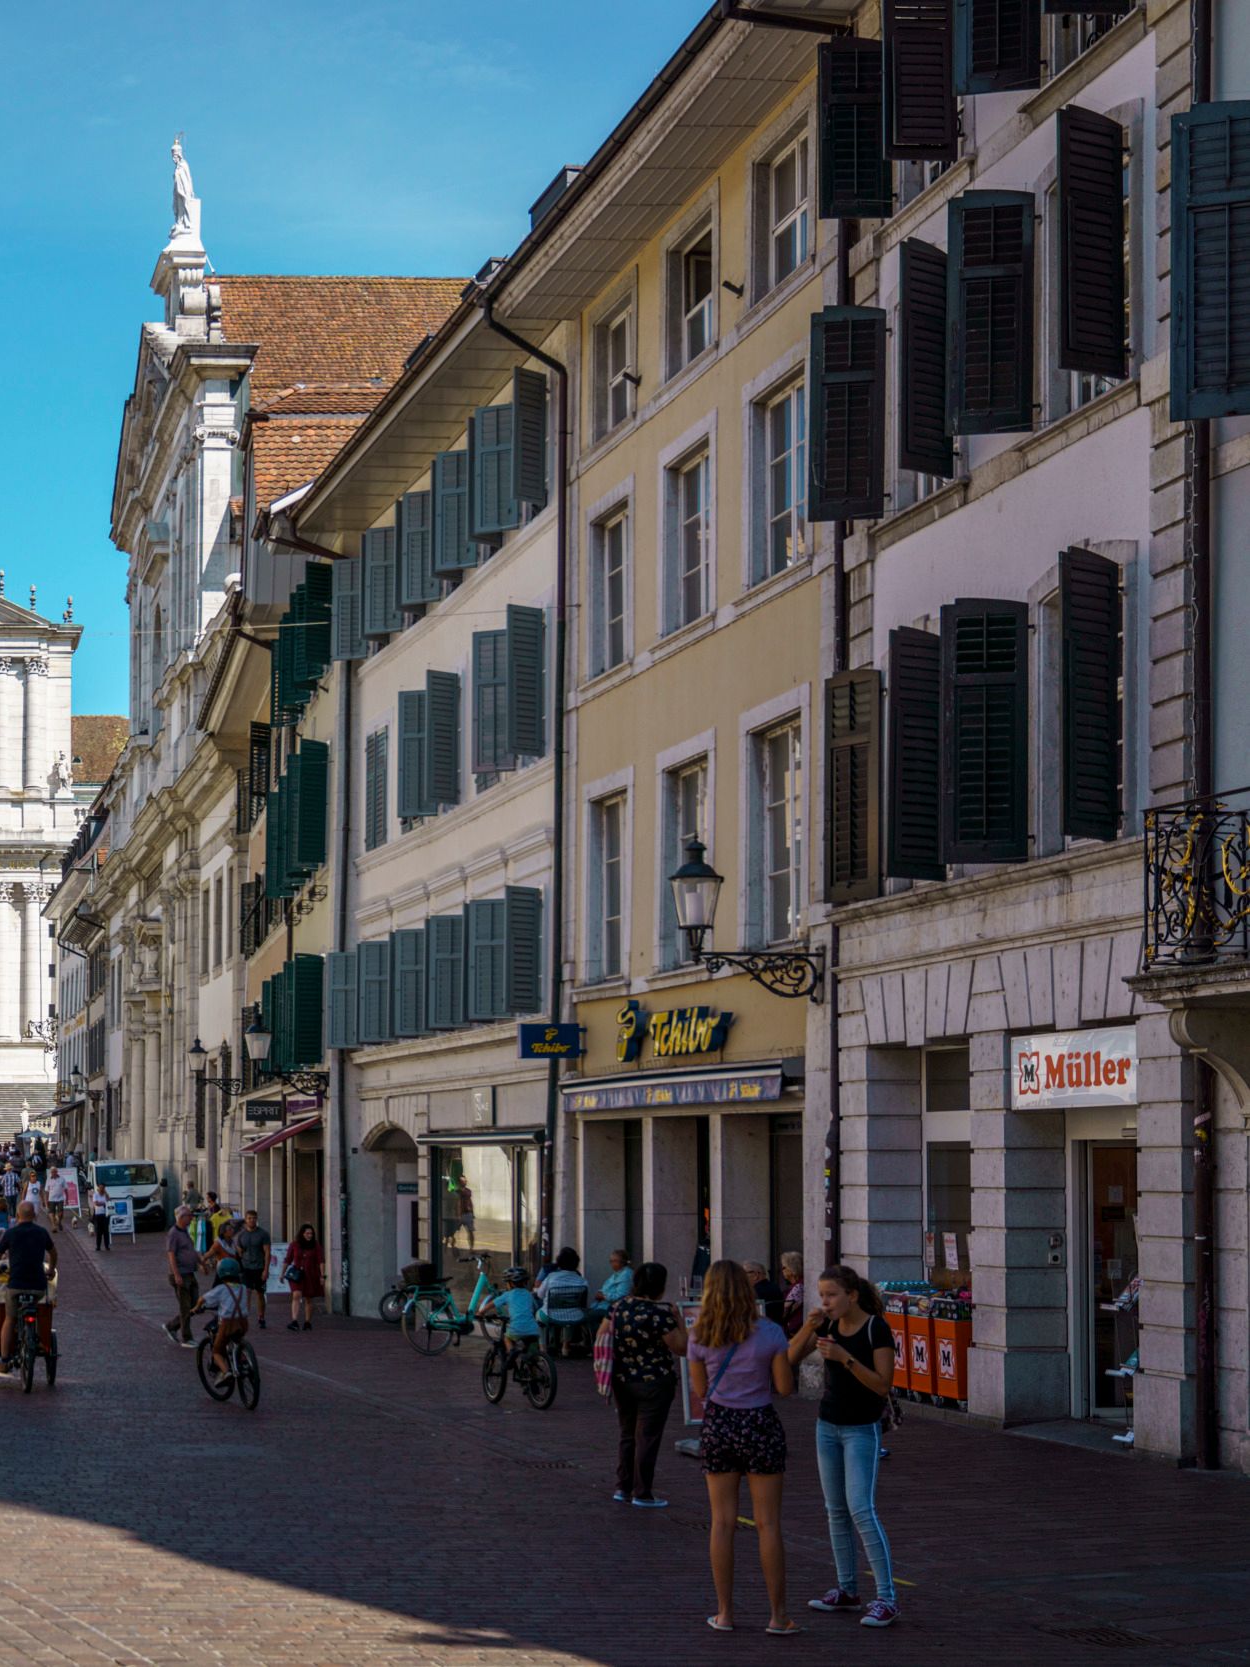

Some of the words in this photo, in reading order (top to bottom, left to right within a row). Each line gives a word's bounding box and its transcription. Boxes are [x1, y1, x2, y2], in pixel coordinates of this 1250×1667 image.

[649, 1006, 721, 1057] Tchibo
[530, 1042, 572, 1054] Tchibo
[1044, 1050, 1131, 1090] Müller
[248, 1105, 281, 1116] ESPRIT
